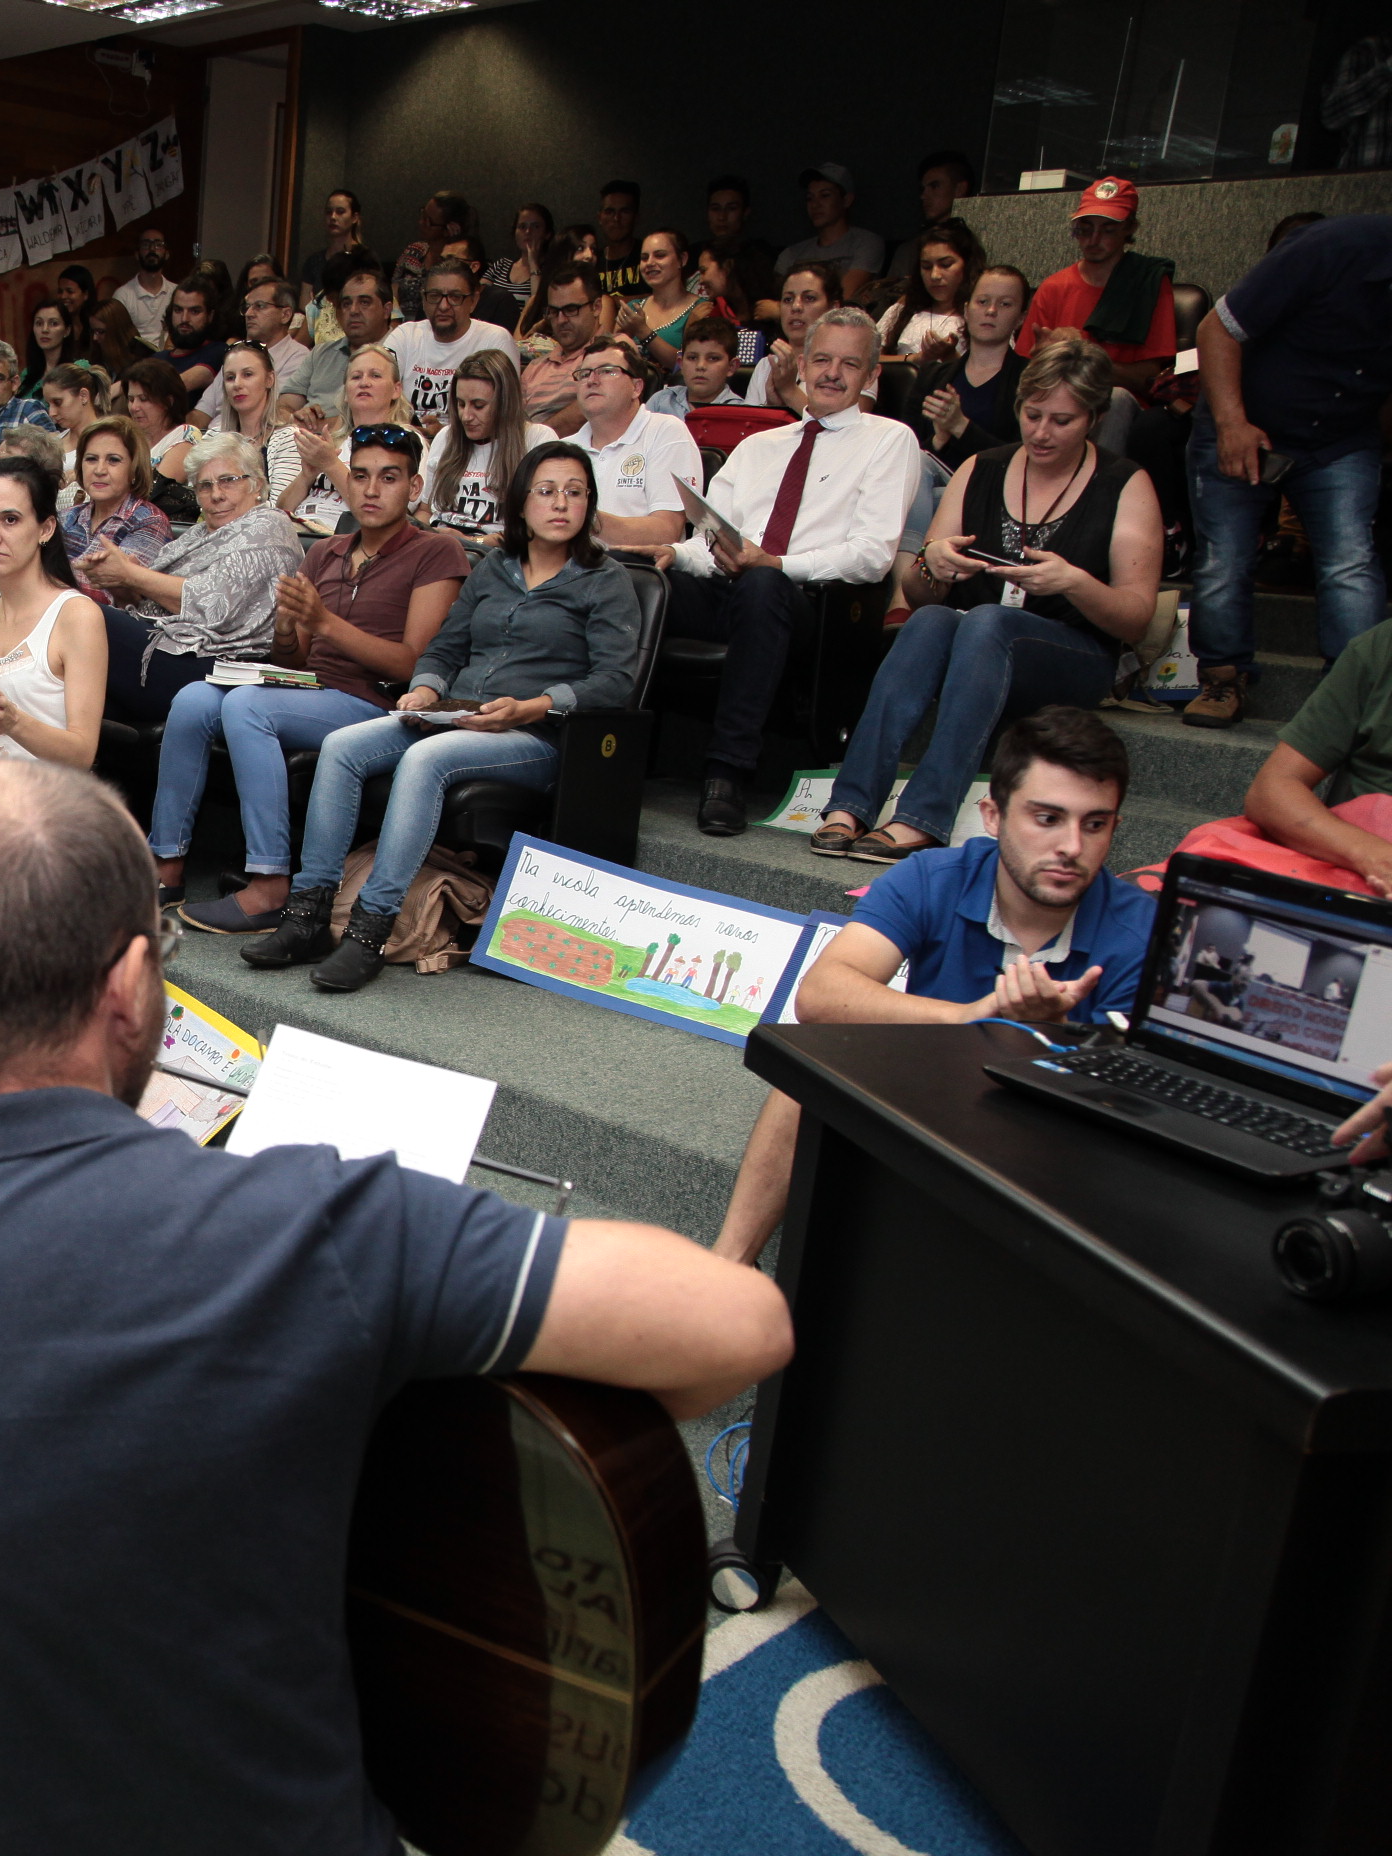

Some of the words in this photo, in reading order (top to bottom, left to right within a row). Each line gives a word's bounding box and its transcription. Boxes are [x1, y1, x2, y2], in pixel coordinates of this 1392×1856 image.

[102, 150, 122, 193] Y
[141, 131, 163, 172] Z
[14, 191, 44, 224] W
[62, 169, 90, 212] X
[552, 869, 601, 899] escola
